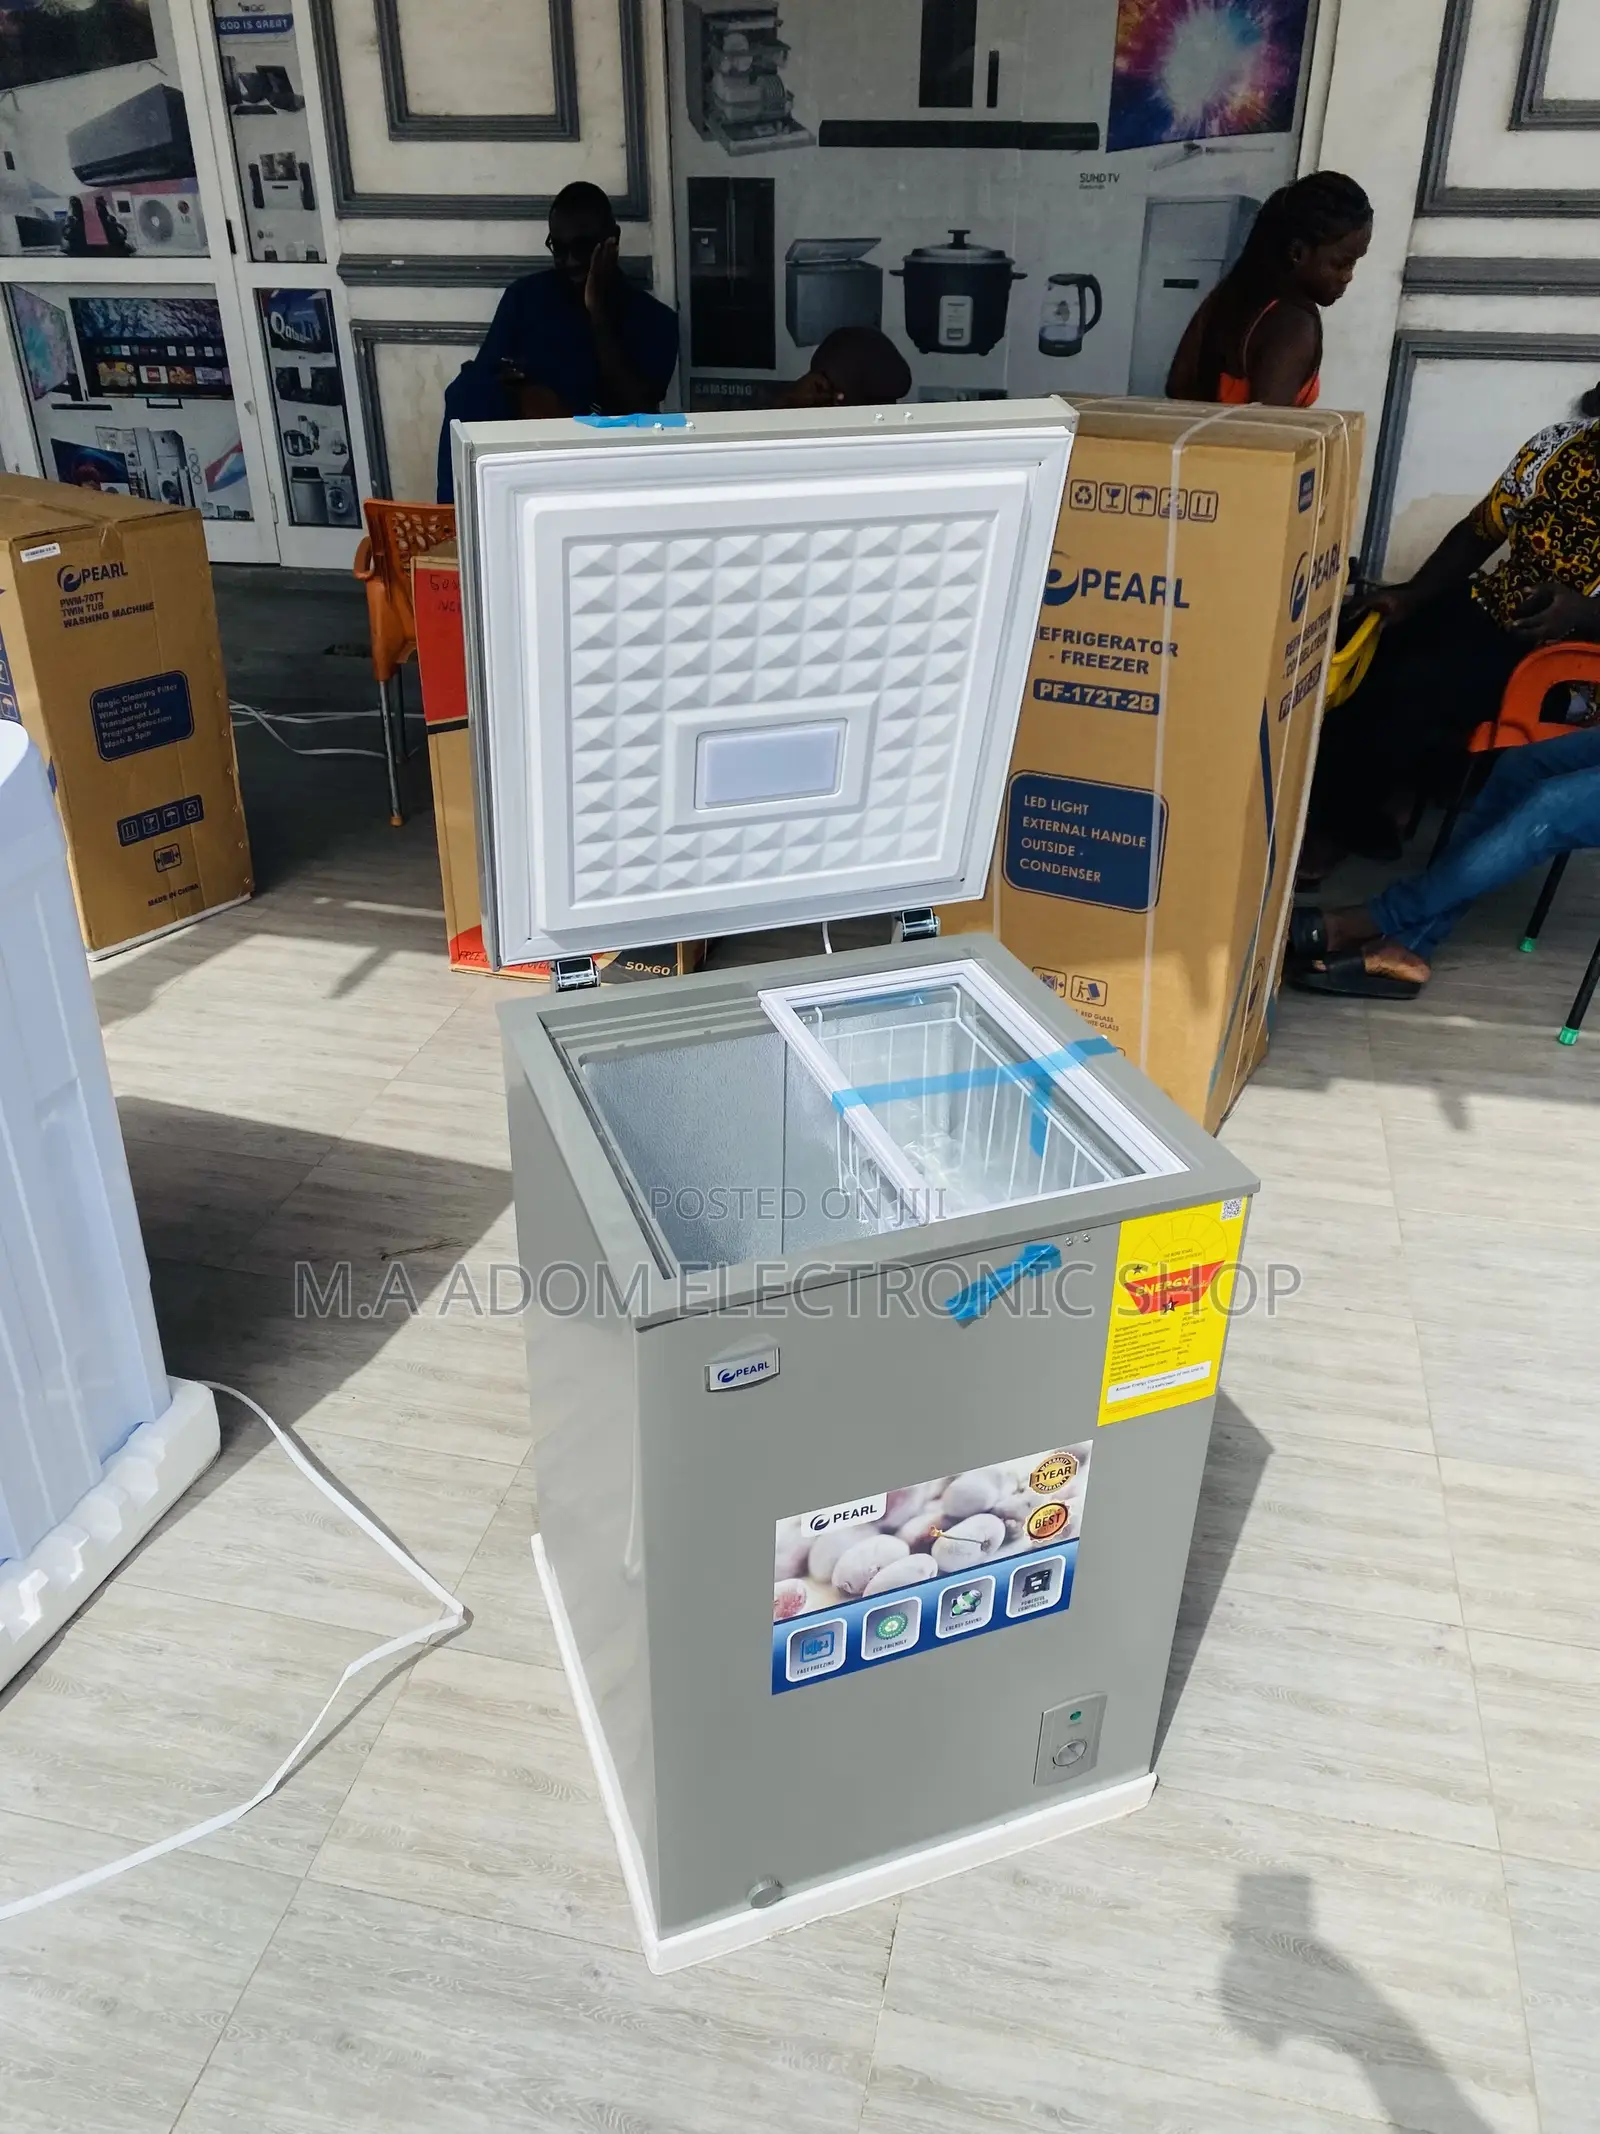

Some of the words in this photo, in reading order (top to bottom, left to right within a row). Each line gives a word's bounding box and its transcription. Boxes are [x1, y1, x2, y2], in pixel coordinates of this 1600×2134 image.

[220, 21, 240, 30] GOD
[243, 21, 253, 29] IS
[1108, 172, 1120, 183] TV
[695, 382, 752, 396] SAMSUNG
[81, 561, 128, 583] PEARL
[1081, 567, 1190, 609] PEARL
[60, 591, 104, 608] PWM-70TT
[61, 606, 84, 617] TWIN
[87, 602, 104, 613] TUB
[63, 612, 110, 628] WASHING
[112, 601, 155, 618] MACHINE
[1036, 625, 1178, 658] EFRIGERATOR
[1061, 649, 1150, 675] FREEZER
[97, 697, 120, 710] Magic
[122, 689, 156, 703] Cleaning
[157, 684, 177, 693] Filter
[1039, 682, 1155, 712] PF-172T-2B
[98, 709, 119, 719] Wind
[120, 705, 132, 714] Jet
[134, 702, 148, 710] Dry
[100, 711, 147, 728] Transparent
[137, 715, 172, 729] Selection
[104, 737, 125, 748] Wash
[135, 731, 151, 740] Spin
[1024, 794, 1047, 809] LED
[1051, 799, 1089, 816] LIGHT
[1022, 816, 1087, 838] EXTERNAL
[1091, 827, 1147, 848] HANDLE
[1021, 837, 1075, 856] OUTSIDE
[1020, 858, 1101, 882] CONDENSER
[459, 950, 480, 961] FREE
[624, 960, 671, 976] 50x60
[1094, 1013, 1114, 1023] GLASS
[1099, 1022, 1120, 1032] GLASS
[1136, 1275, 1192, 1296] ENERGY
[736, 1361, 770, 1378] PEARL
[1042, 1466, 1072, 1480] YEAR
[833, 1504, 878, 1523] PEARL
[1035, 1512, 1062, 1529] BEST
